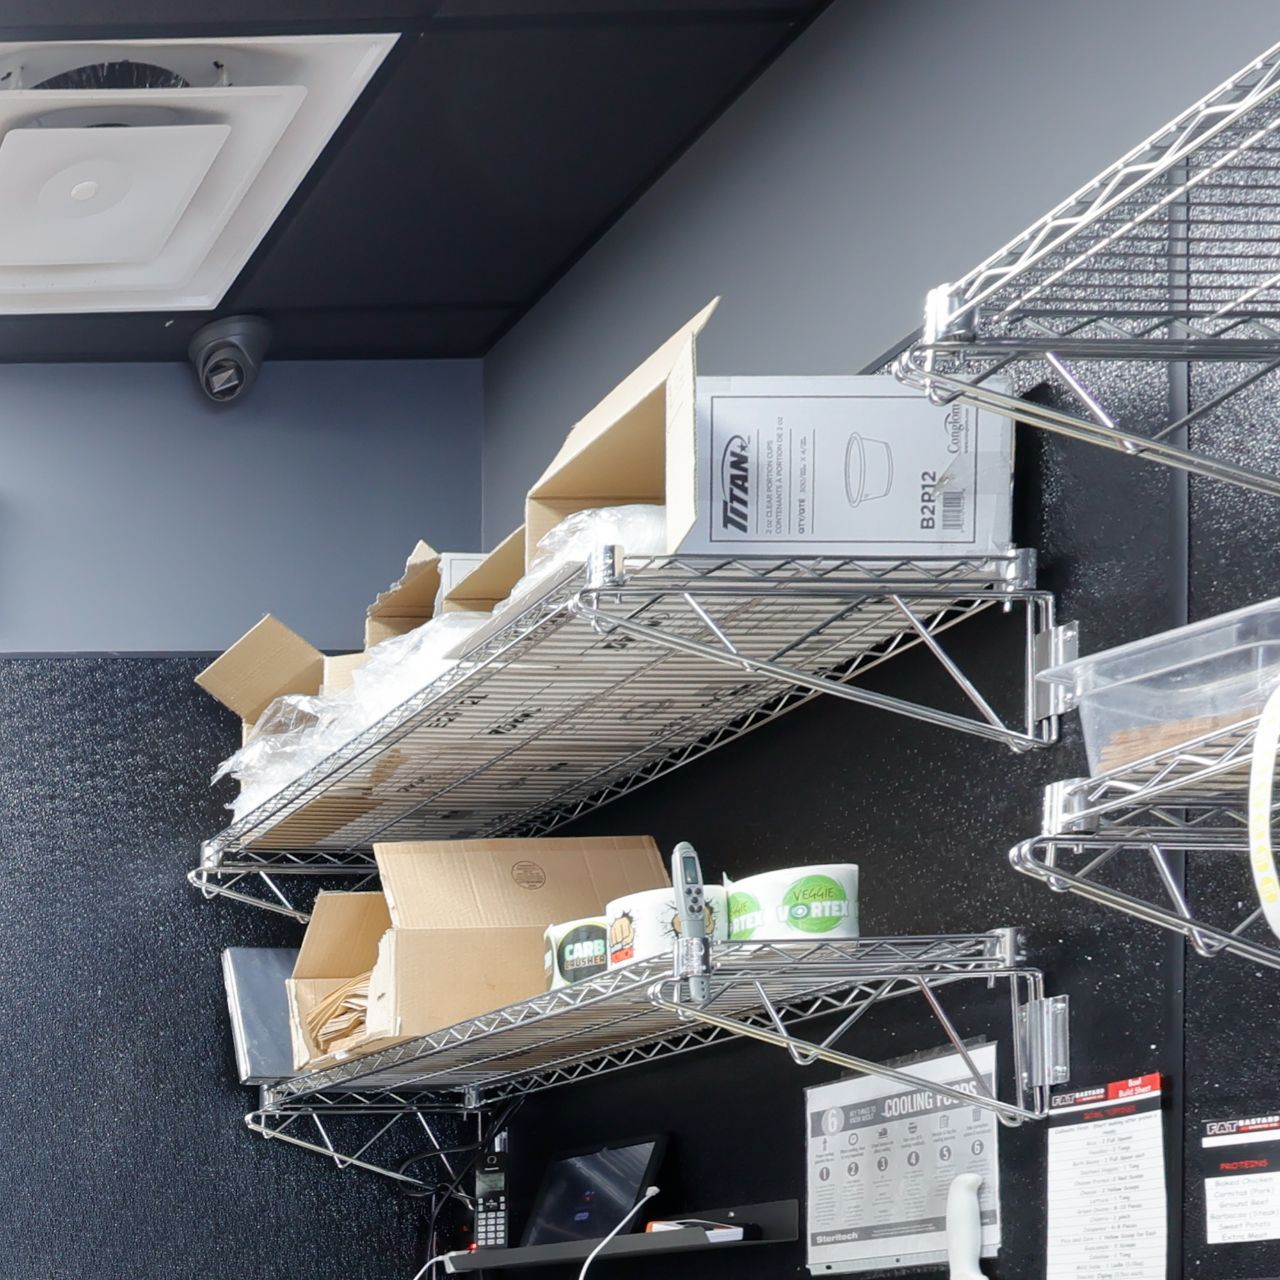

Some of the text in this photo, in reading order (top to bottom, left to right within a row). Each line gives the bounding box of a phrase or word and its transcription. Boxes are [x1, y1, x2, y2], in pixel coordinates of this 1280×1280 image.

[946, 403, 965, 454] Conglom
[766, 460, 774, 493] PORTION
[722, 450, 748, 534] TITAN
[920, 471, 937, 530] B2P12
[792, 887, 836, 901] VEGGIE
[776, 900, 849, 922] VORTEX
[564, 939, 606, 960] CARB
[563, 954, 607, 971] CRUSHER
[884, 1092, 933, 1118] COOLING
[1052, 1093, 1075, 1106] FAT
[826, 1107, 839, 1134] 6
[1206, 1115, 1280, 1135] FAT BASTARD
[816, 1232, 858, 1243] Steritech
